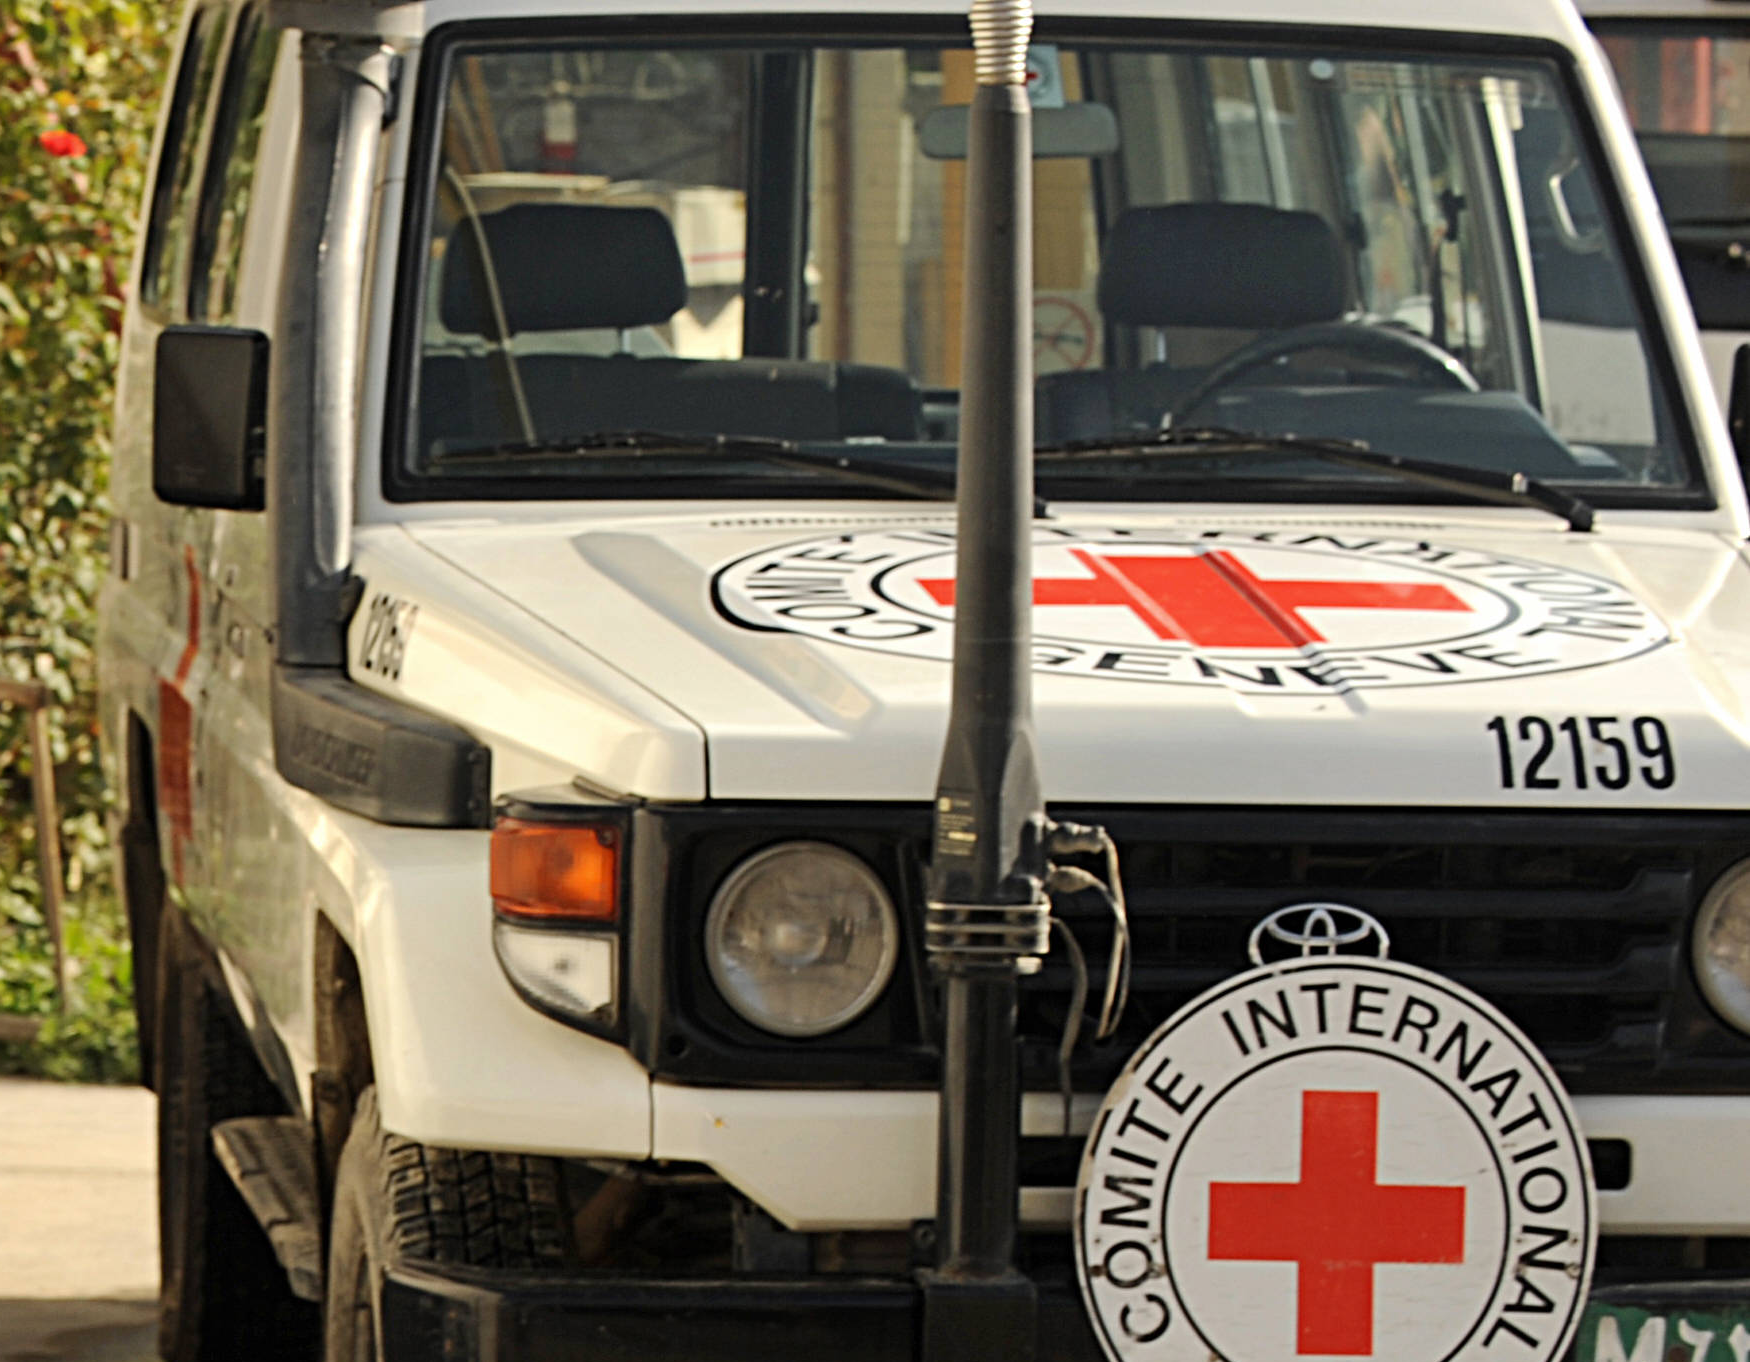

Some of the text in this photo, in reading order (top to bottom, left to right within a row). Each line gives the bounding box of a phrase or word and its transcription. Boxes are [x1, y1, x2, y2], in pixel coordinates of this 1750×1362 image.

[1487, 715, 1676, 790] 12159
[1100, 983, 1570, 1350] COMITE INTERNATIONAL
